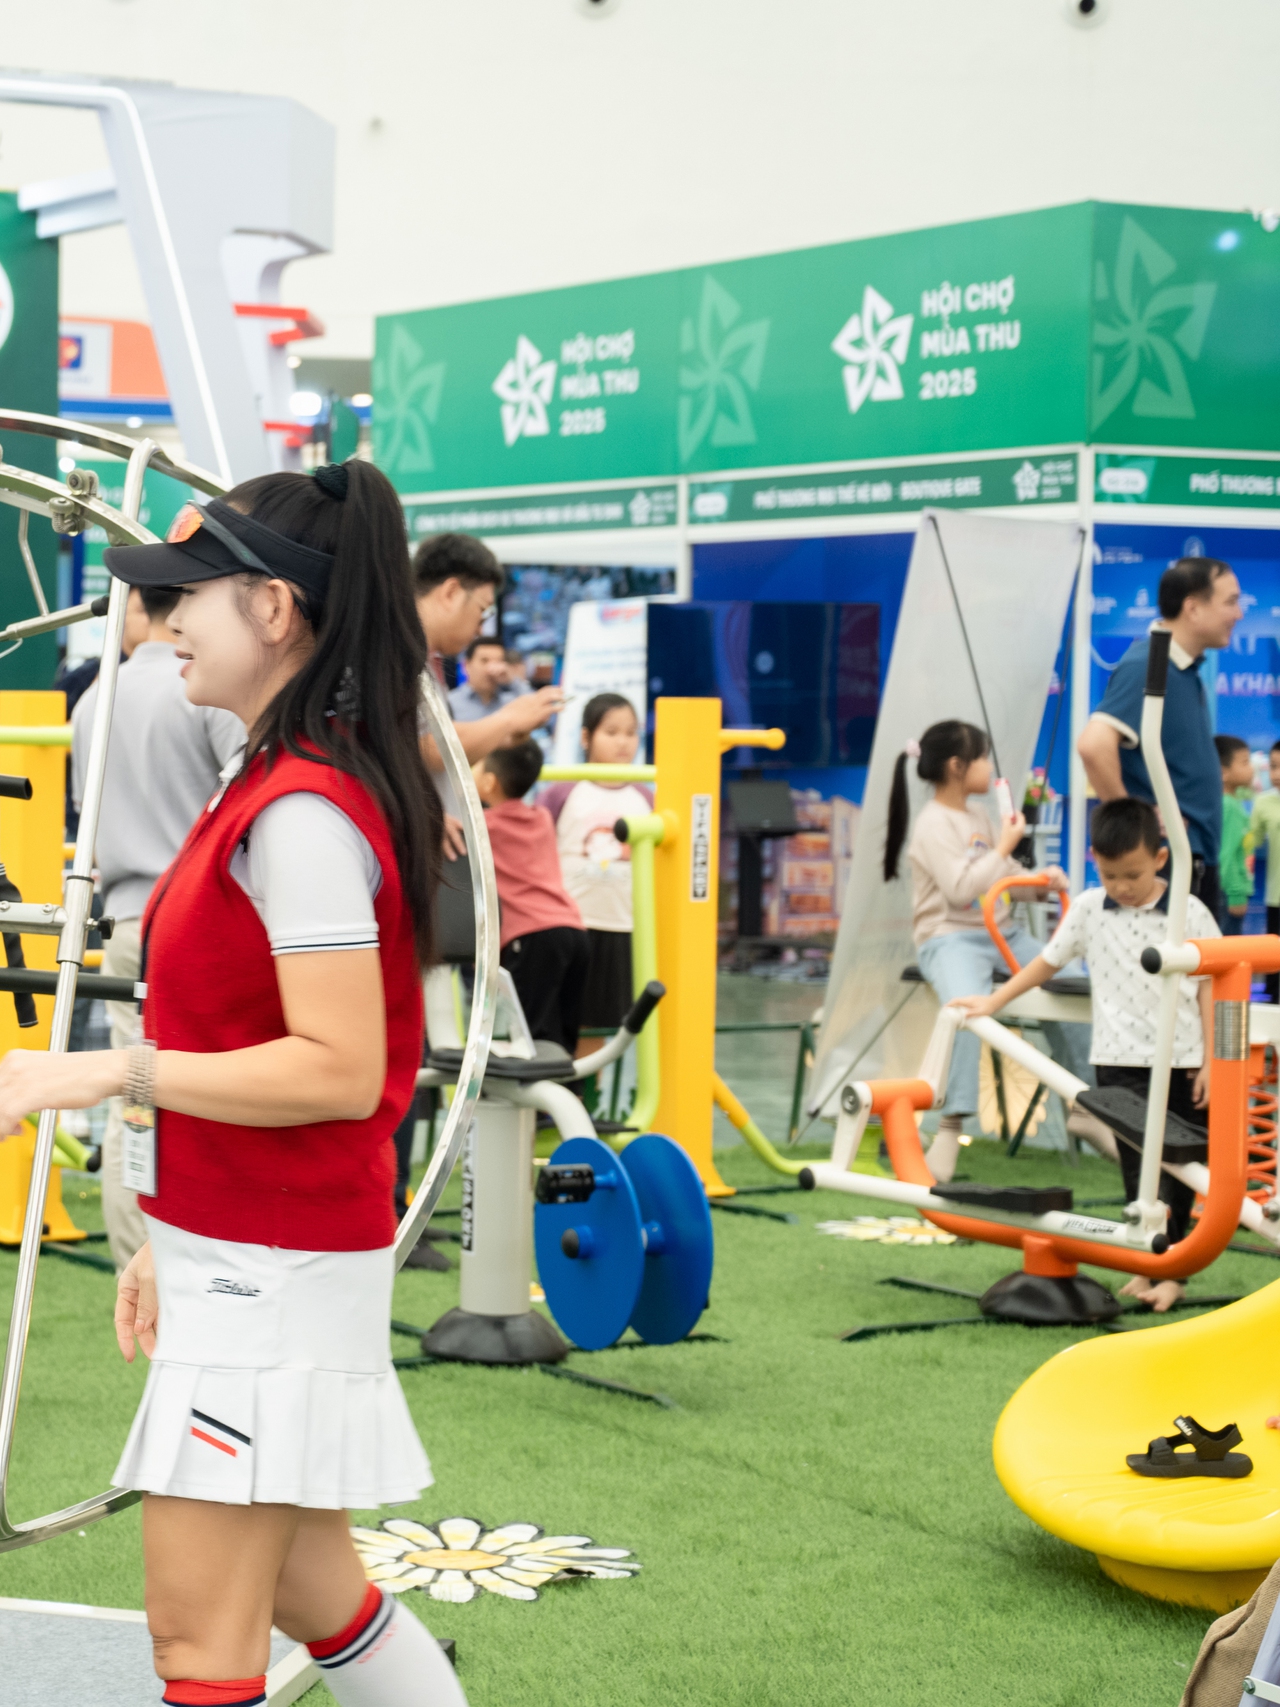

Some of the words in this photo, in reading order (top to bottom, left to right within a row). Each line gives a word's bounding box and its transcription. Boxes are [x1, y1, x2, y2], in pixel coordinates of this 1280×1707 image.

[921, 280, 961, 319] HỘI
[964, 274, 1015, 315] CHỢ
[560, 331, 594, 366] HỘI
[595, 327, 635, 364] CHỢ
[921, 322, 971, 359] MÙA
[973, 319, 1021, 353] THU
[560, 364, 602, 401] MÙA
[602, 366, 640, 396] THU
[919, 366, 977, 400] 2025
[559, 406, 606, 436] 2025
[1189, 469, 1221, 493] PHỐ
[1232, 672, 1280, 697] KHA
